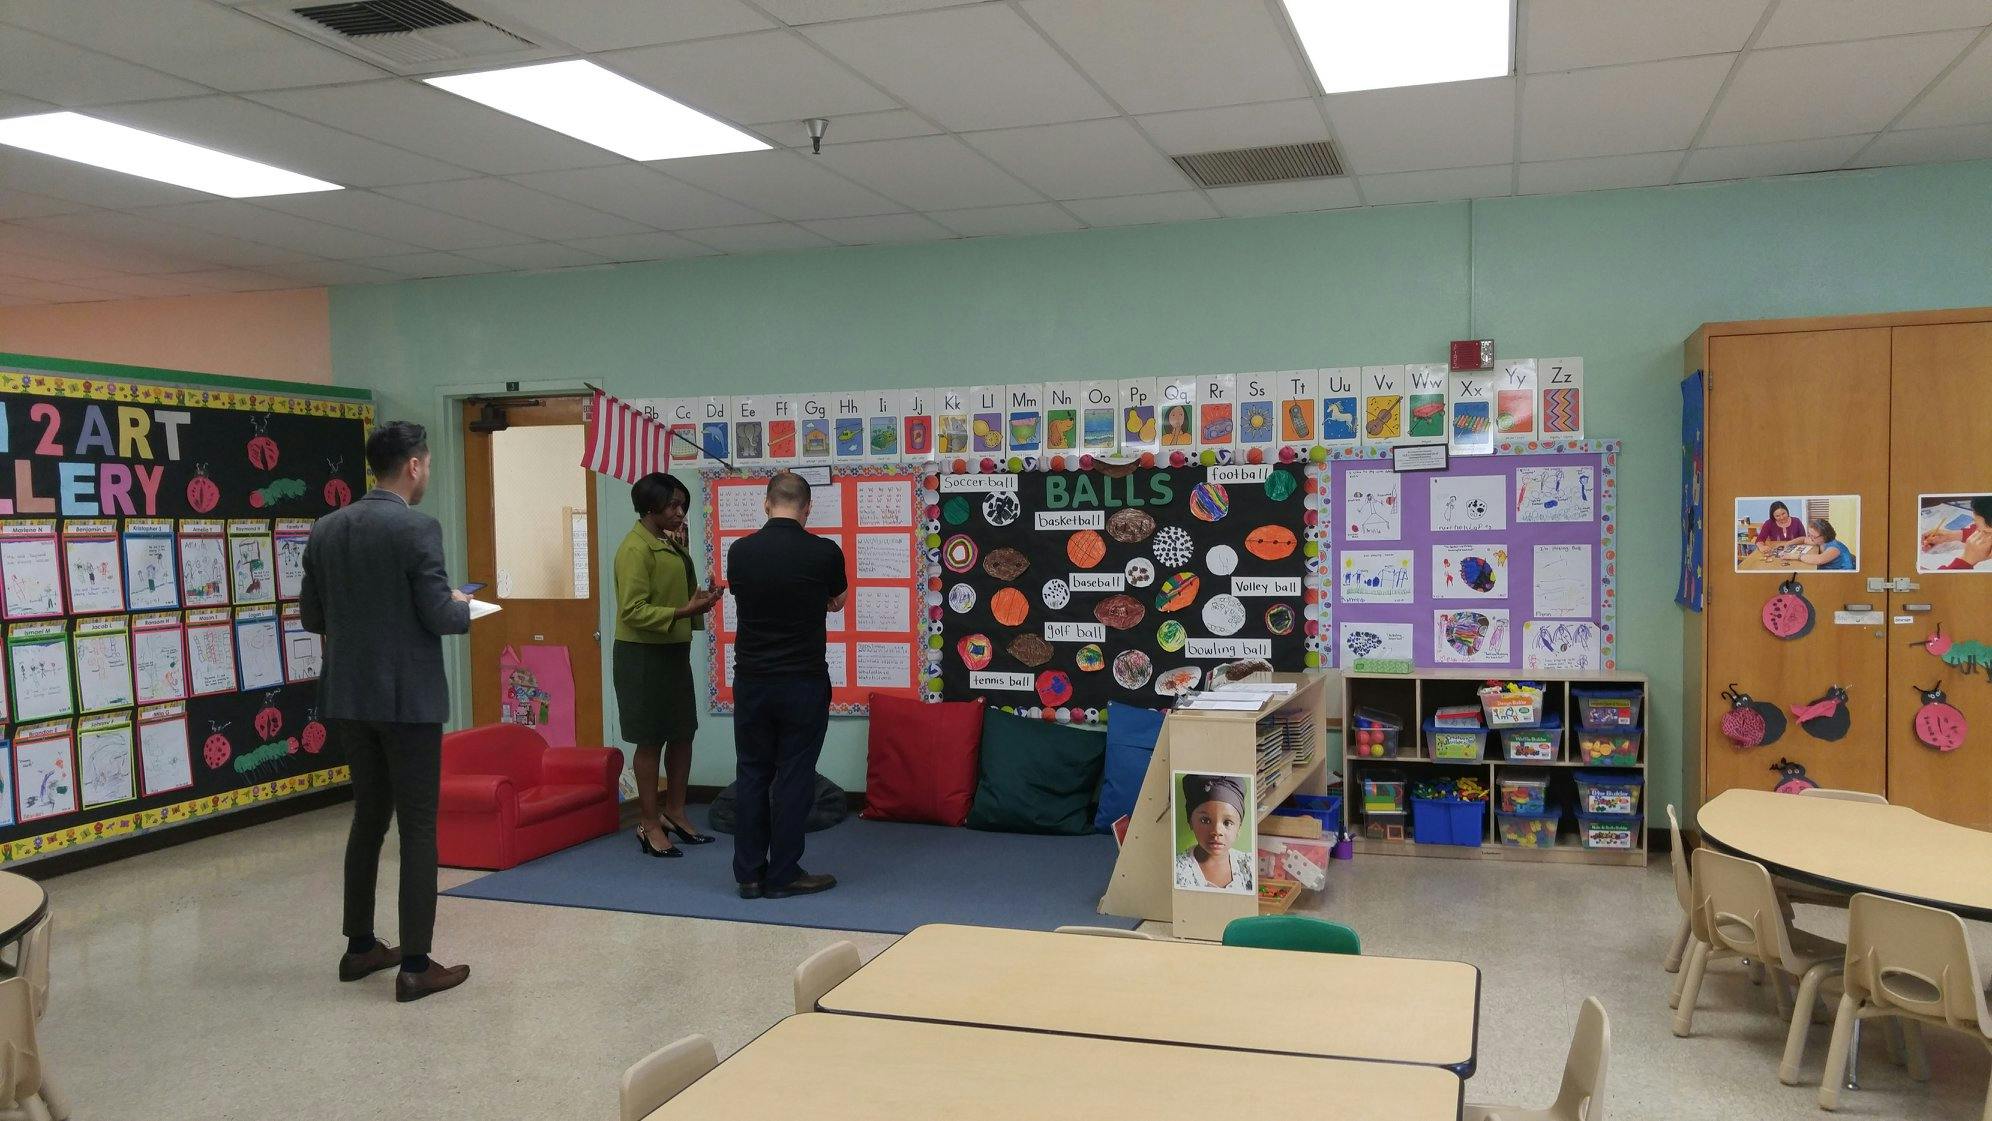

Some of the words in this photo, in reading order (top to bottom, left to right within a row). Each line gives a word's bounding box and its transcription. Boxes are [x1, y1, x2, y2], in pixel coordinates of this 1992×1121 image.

[1373, 374, 1394, 391] Vv
[1411, 373, 1443, 390] Ww
[1504, 367, 1526, 389] Yy
[1551, 366, 1572, 384] Zz
[1209, 383, 1224, 399] Rr
[1249, 381, 1266, 397] Ss
[1290, 378, 1306, 395] Tt
[1330, 376, 1351, 393] Uu
[1461, 380, 1482, 397] Xx
[944, 395, 961, 411] Kk
[982, 394, 994, 409] Ll
[1012, 392, 1037, 408] Mm
[1052, 390, 1072, 405] Nn
[1088, 388, 1111, 404] Oo
[1130, 386, 1147, 405] Pp
[1164, 385, 1190, 405] Qq
[644, 406, 659, 420] Bb
[675, 405, 691, 419] Cc
[706, 403, 724, 418] Dd
[741, 402, 756, 417] Ee
[775, 401, 788, 416] Ff
[804, 400, 825, 419] Gg
[839, 399, 858, 414] Hh
[879, 397, 887, 413] Ii
[912, 396, 924, 416] Jj
[30, 403, 64, 456] 2
[75, 404, 191, 461] ART
[1212, 467, 1268, 481] football
[1046, 473, 1173, 509] BALLS
[1038, 514, 1100, 528] basketball
[1073, 575, 1120, 588] baseball
[1235, 581, 1268, 593] Volley
[1275, 581, 1296, 593] ball
[1047, 624, 1070, 639] golf
[1077, 624, 1102, 640] ball
[1188, 641, 1236, 657] bowling
[1242, 642, 1267, 656] ball
[973, 675, 1005, 686] tennis
[1009, 675, 1029, 687] ball
